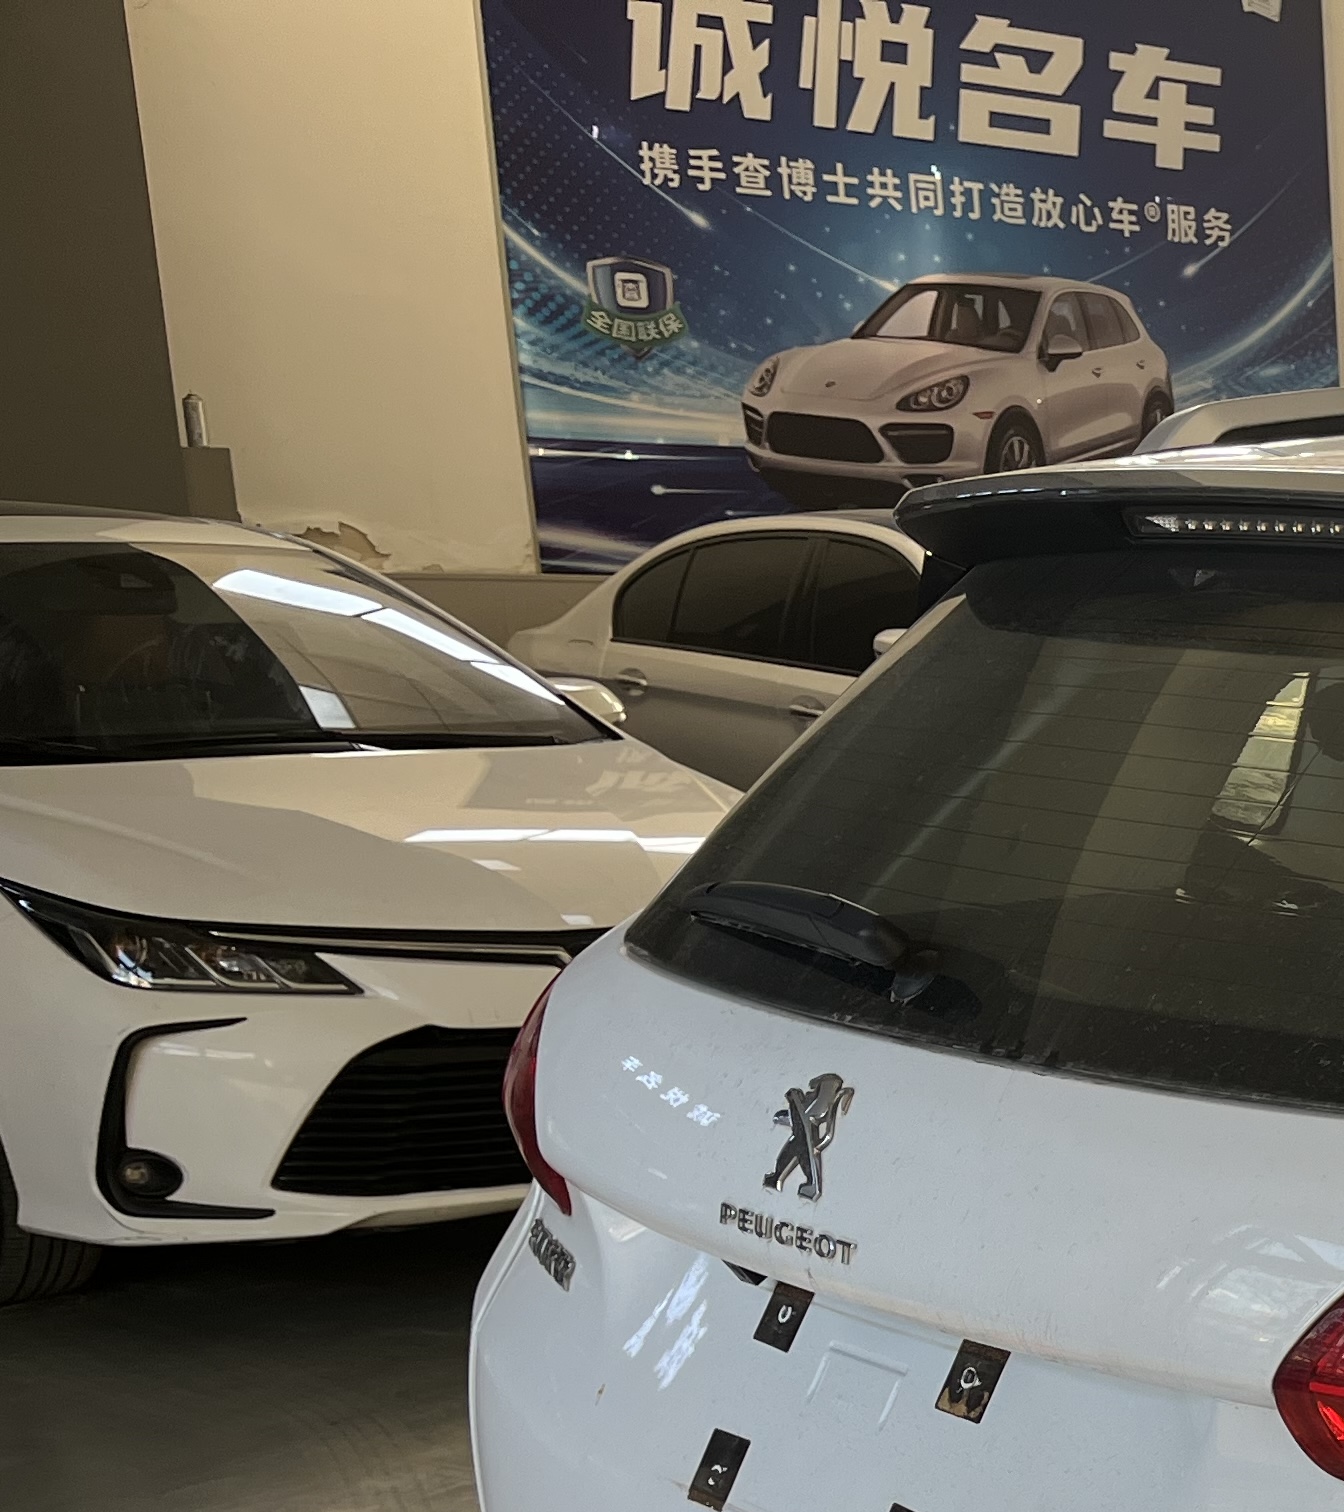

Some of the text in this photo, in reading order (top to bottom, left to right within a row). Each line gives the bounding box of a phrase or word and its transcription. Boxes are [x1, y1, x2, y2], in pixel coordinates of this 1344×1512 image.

[626, 0, 1222, 170] 诚悦名车
[586, 310, 684, 341] 全国联保
[719, 1201, 858, 1266] PEUGEOT
